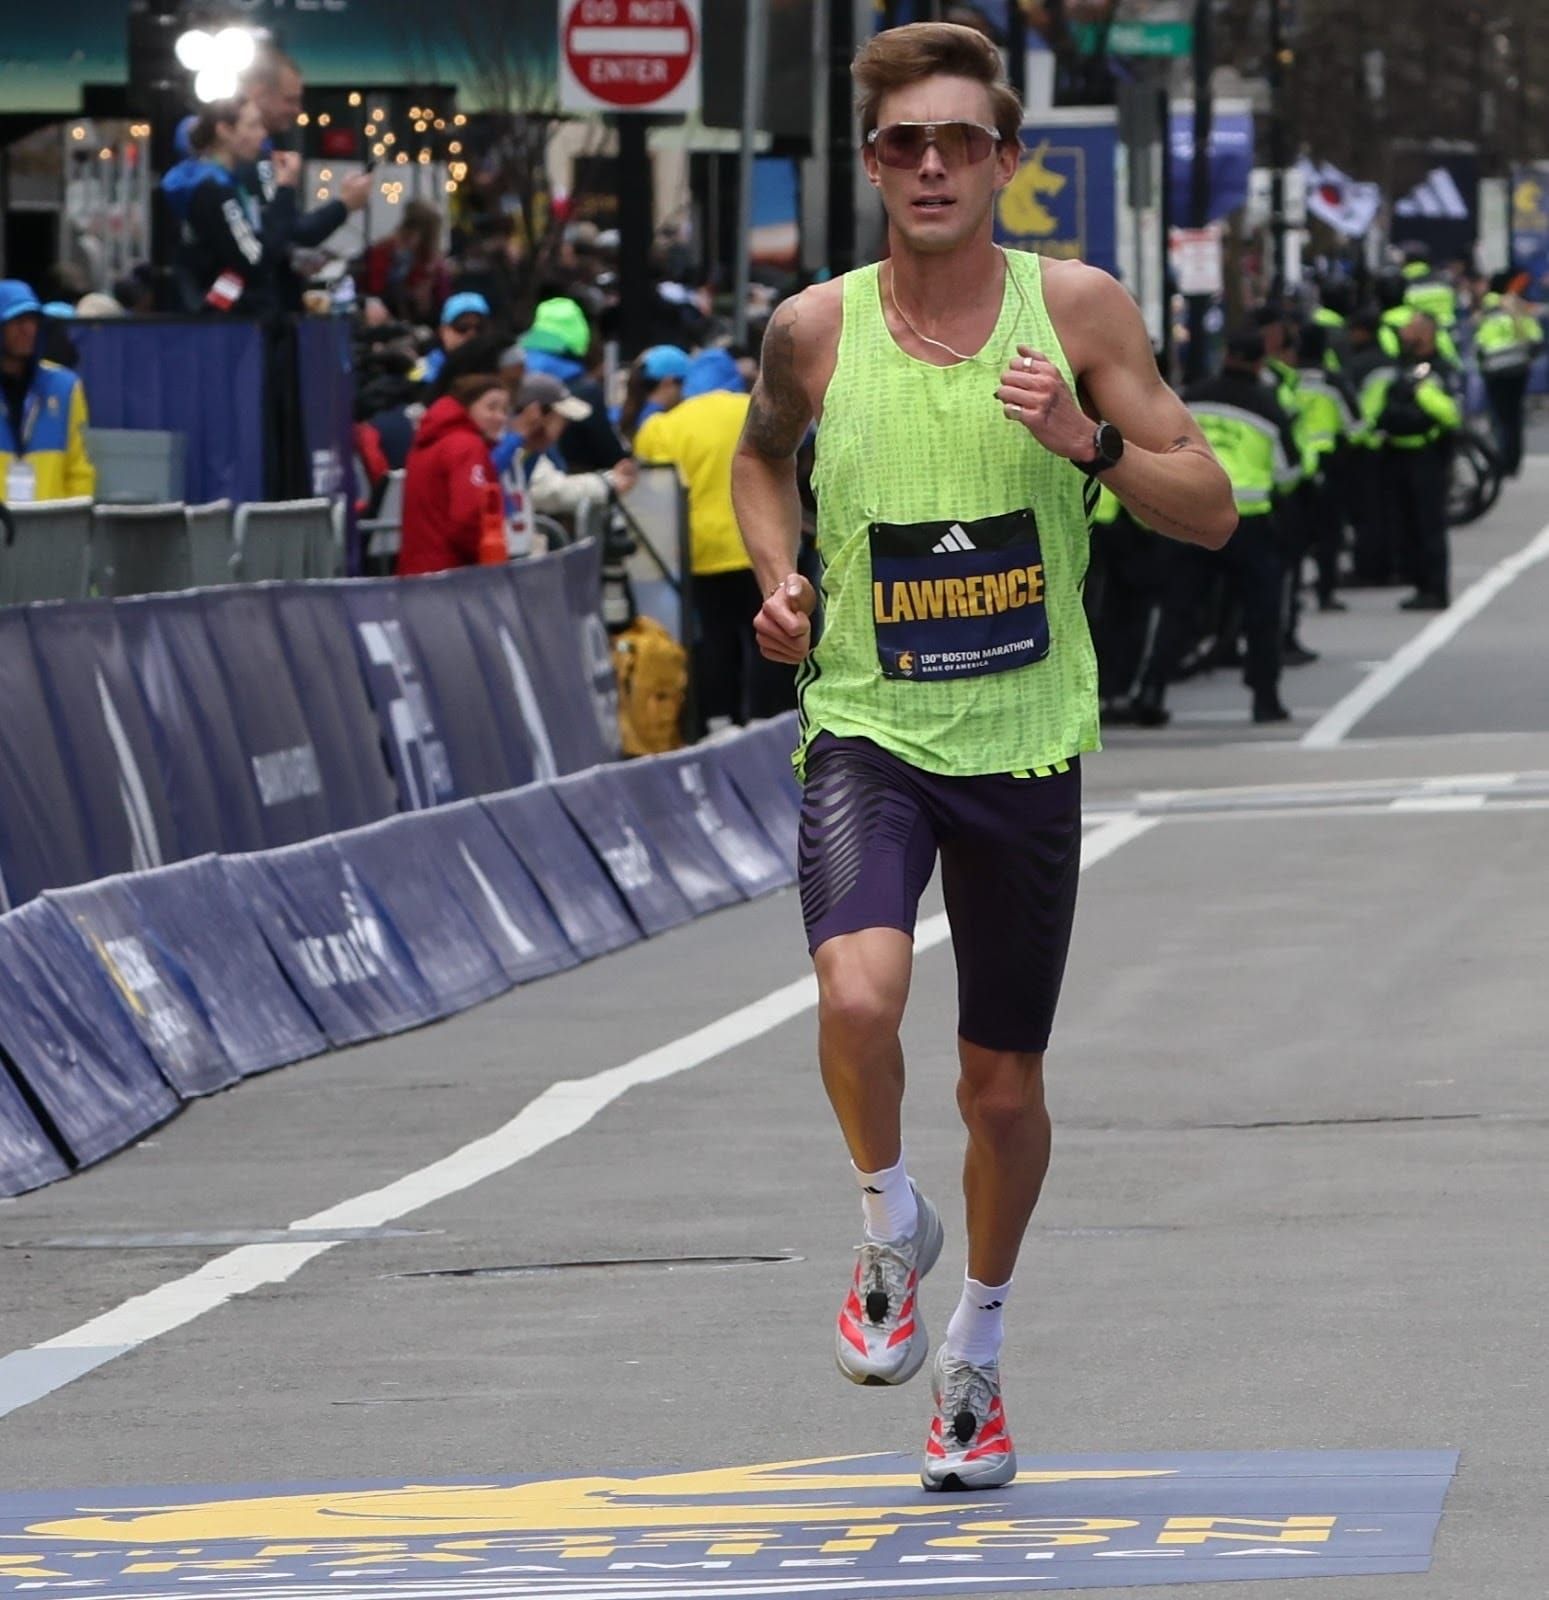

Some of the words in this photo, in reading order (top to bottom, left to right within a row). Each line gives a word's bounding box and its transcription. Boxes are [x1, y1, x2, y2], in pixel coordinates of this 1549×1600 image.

[581, 0, 618, 23] DO
[628, 0, 676, 23] NOT
[589, 58, 668, 84] ENTER
[873, 564, 1044, 624] LAWRENCE
[942, 651, 981, 663] BOSTON
[982, 638, 1035, 658] MARATHON
[922, 665, 943, 673] BANK
[944, 664, 954, 672] OF
[955, 660, 989, 671] AMERICA
[254, 1516, 1337, 1557] BOSTON
[178, 1568, 409, 1581] OF
[460, 1548, 1321, 1575] AMERICA
